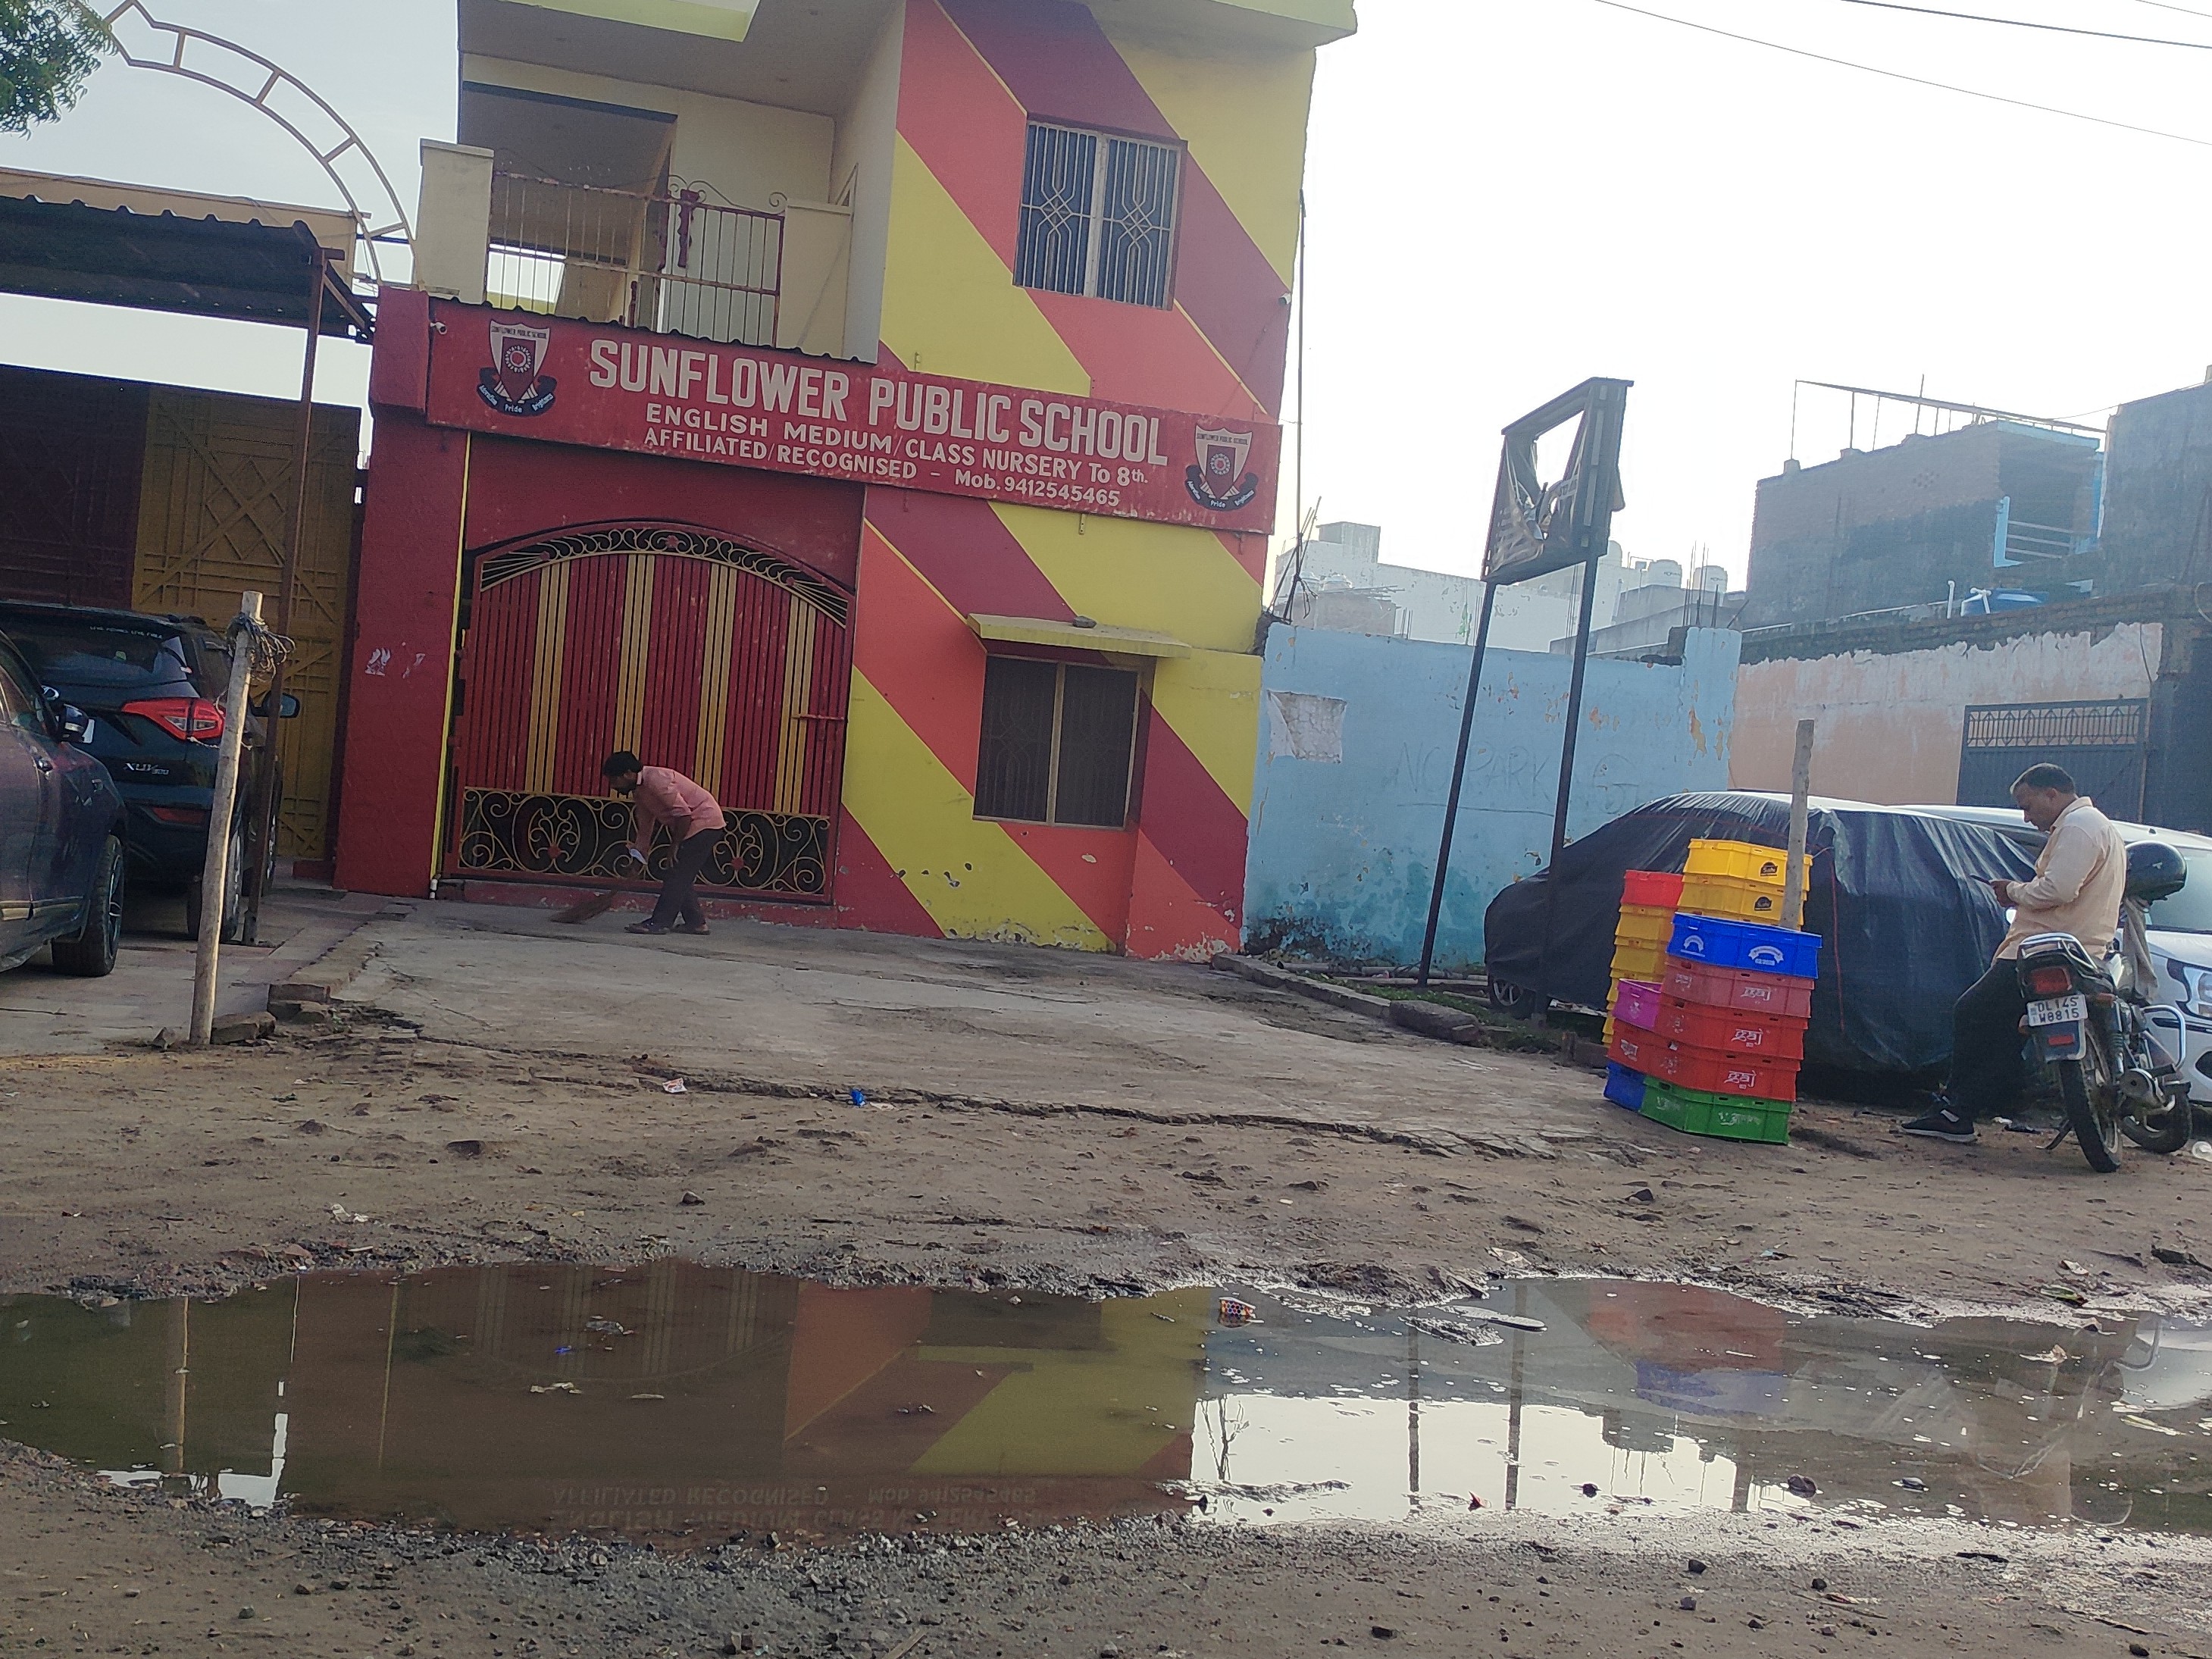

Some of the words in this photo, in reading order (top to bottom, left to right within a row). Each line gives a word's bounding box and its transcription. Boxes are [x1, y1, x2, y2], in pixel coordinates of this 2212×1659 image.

[505, 404, 523, 413] Pride
[590, 339, 849, 423] SUNFLOWER
[869, 377, 1011, 444] PUBLIC
[1018, 399, 1169, 467] SCHOOL
[646, 403, 768, 437] ENGLISH
[983, 448, 1082, 480] NURSERY
[1090, 464, 1110, 485] To
[1210, 499, 1226, 509] Pride
[1468, 740, 1643, 815] PARKNG
